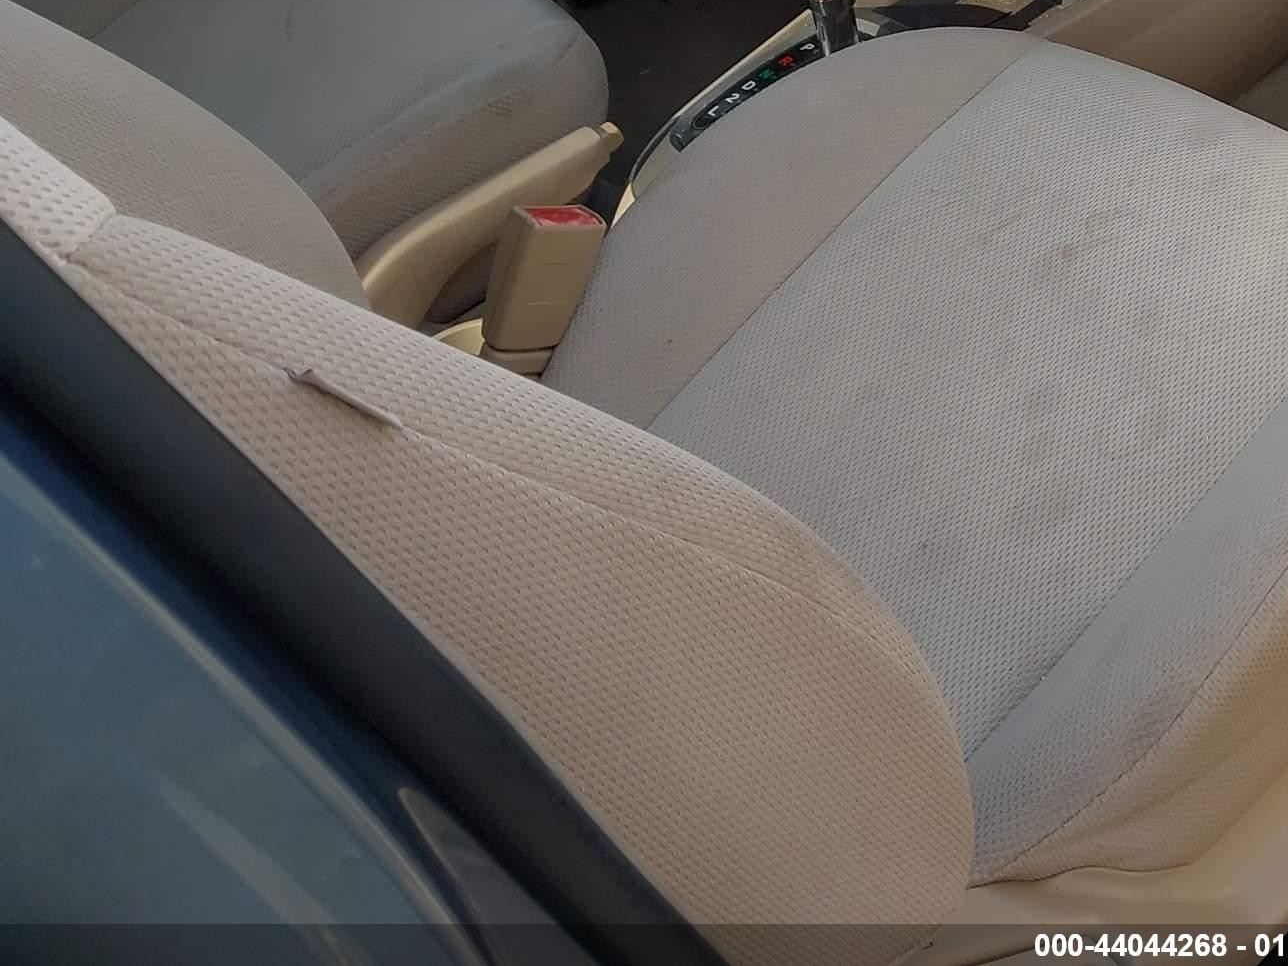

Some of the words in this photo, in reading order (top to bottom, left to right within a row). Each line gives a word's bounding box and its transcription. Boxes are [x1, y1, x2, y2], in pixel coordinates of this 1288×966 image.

[708, 106, 720, 117] L
[726, 93, 740, 103] 2
[742, 80, 756, 91] D
[778, 56, 793, 66] R
[800, 43, 815, 51] P
